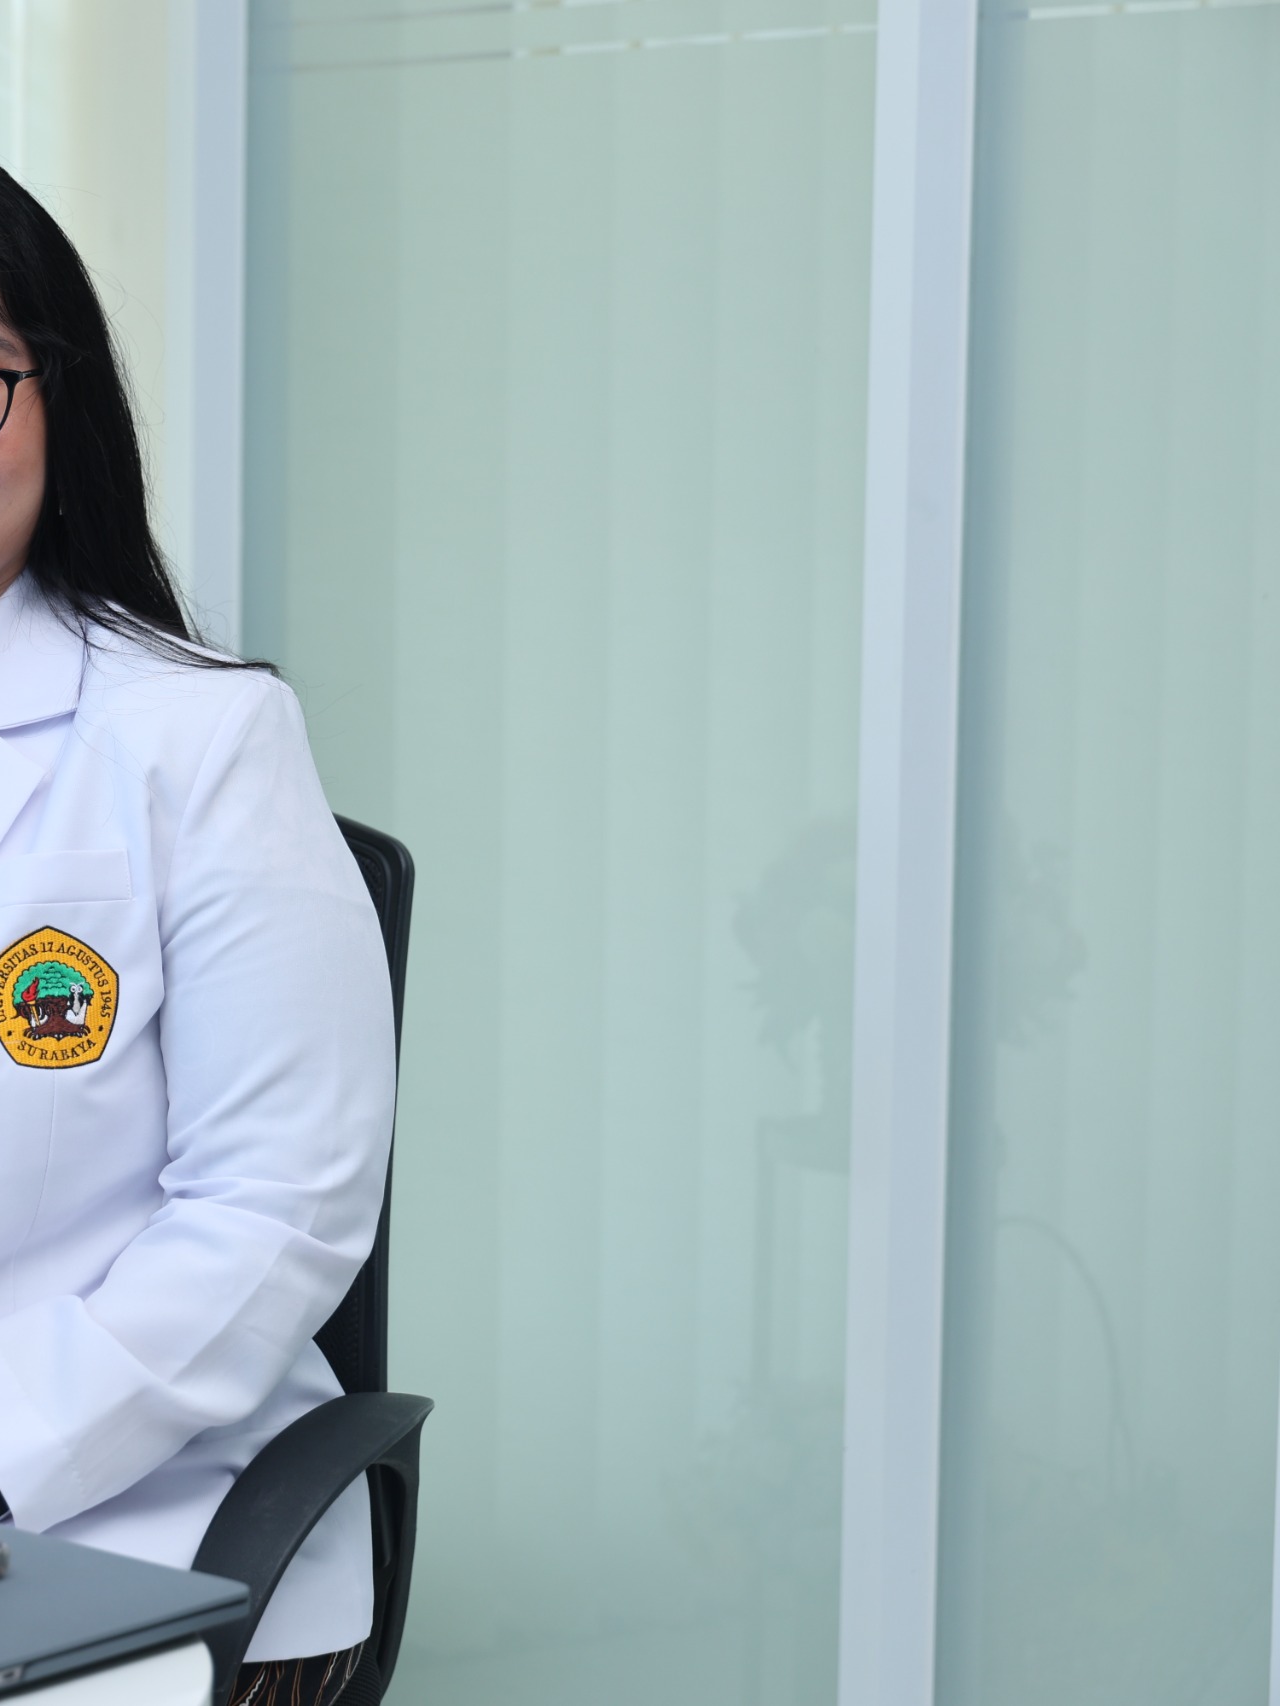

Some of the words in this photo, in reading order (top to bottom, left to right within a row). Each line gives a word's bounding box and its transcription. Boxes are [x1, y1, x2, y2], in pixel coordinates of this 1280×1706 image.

[40, 941, 54, 953] 17
[55, 943, 109, 988] AGUSTUS
[100, 989, 113, 1019] 1945
[17, 1038, 97, 1061] SURABAYA
